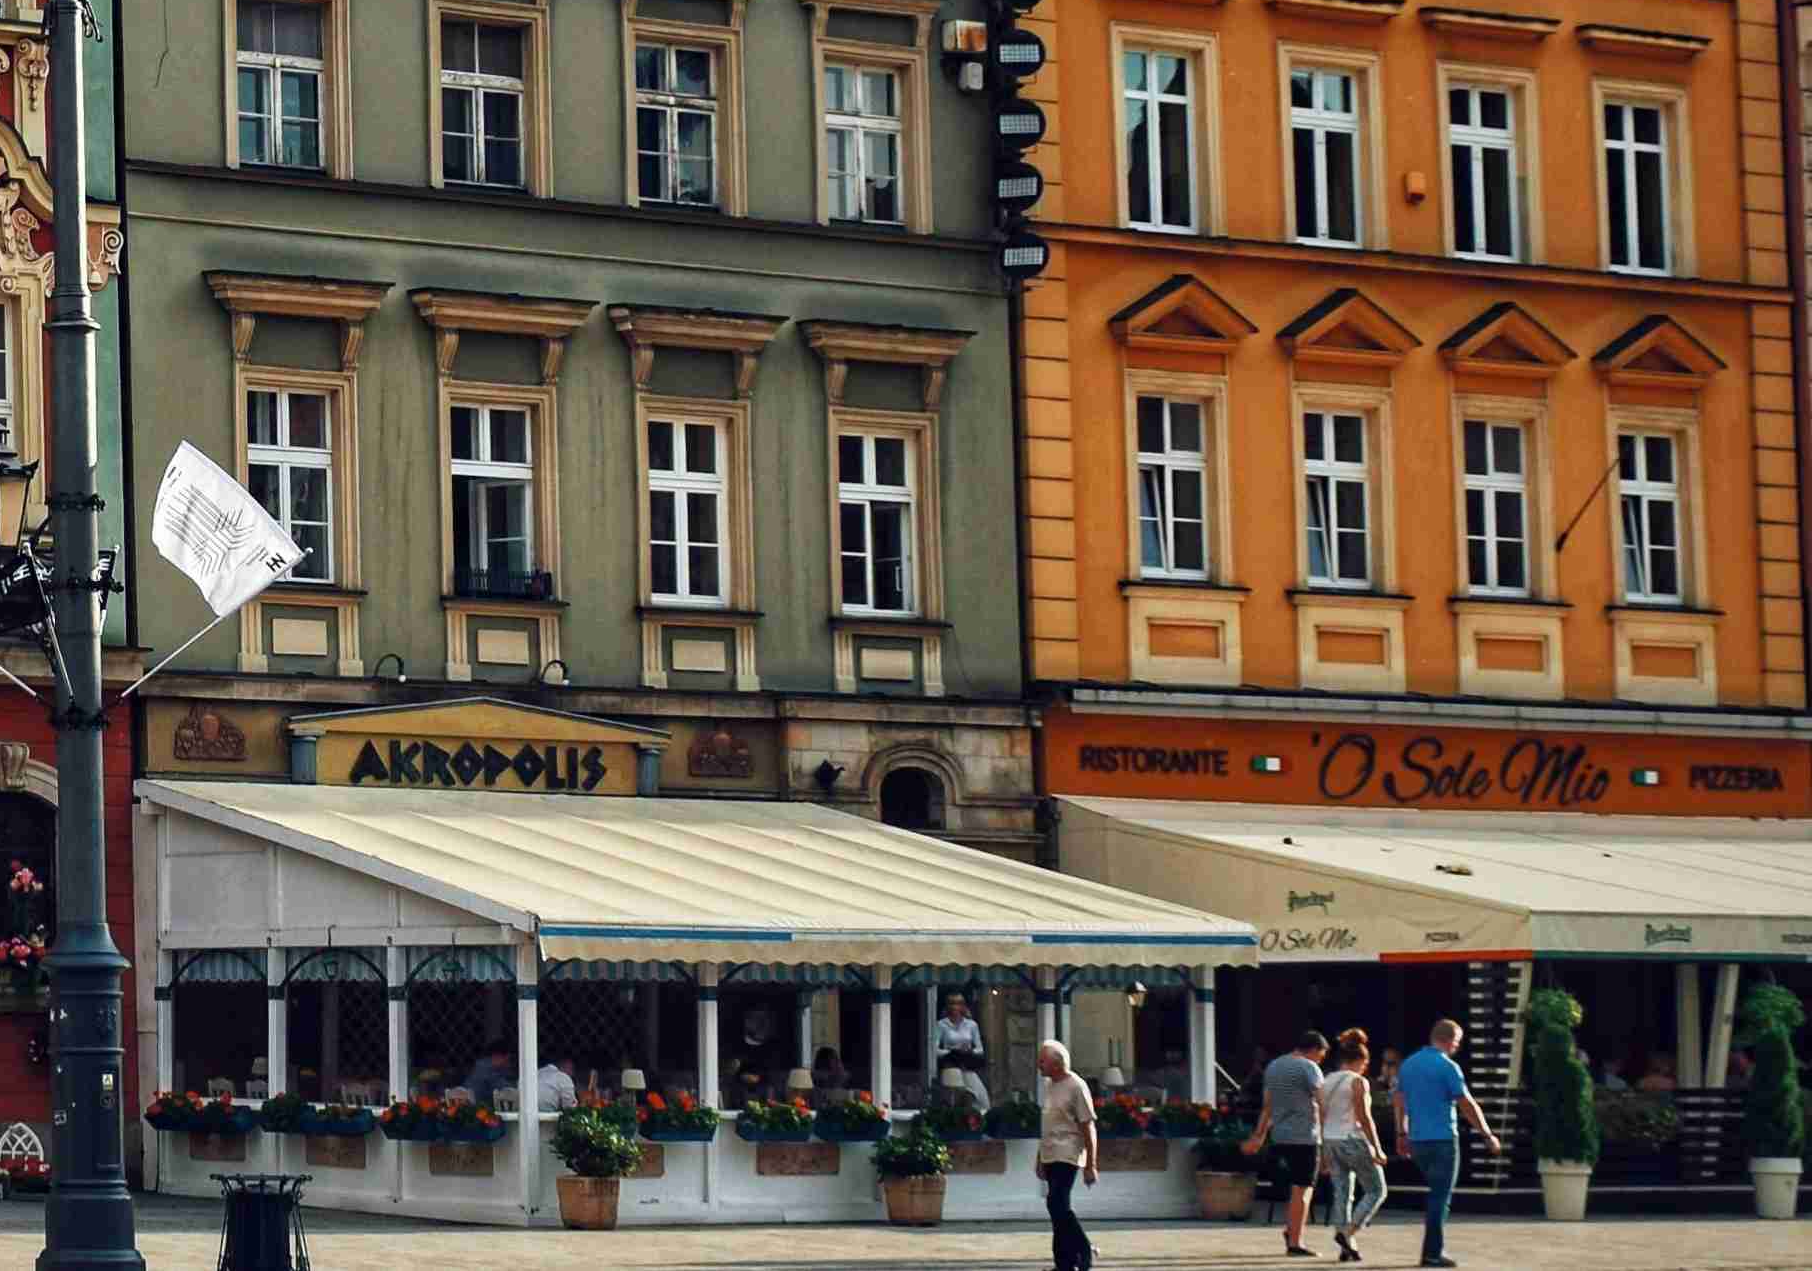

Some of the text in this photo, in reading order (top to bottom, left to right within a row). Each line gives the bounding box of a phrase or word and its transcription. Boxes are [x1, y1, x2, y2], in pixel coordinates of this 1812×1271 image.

[349, 739, 607, 791] AKROPOLIS
[1078, 745, 1229, 776] RISTORANTE
[1382, 735, 1491, 803] Sole
[1500, 738, 1610, 805] Mio
[1690, 764, 1784, 792] PIZZERIA
